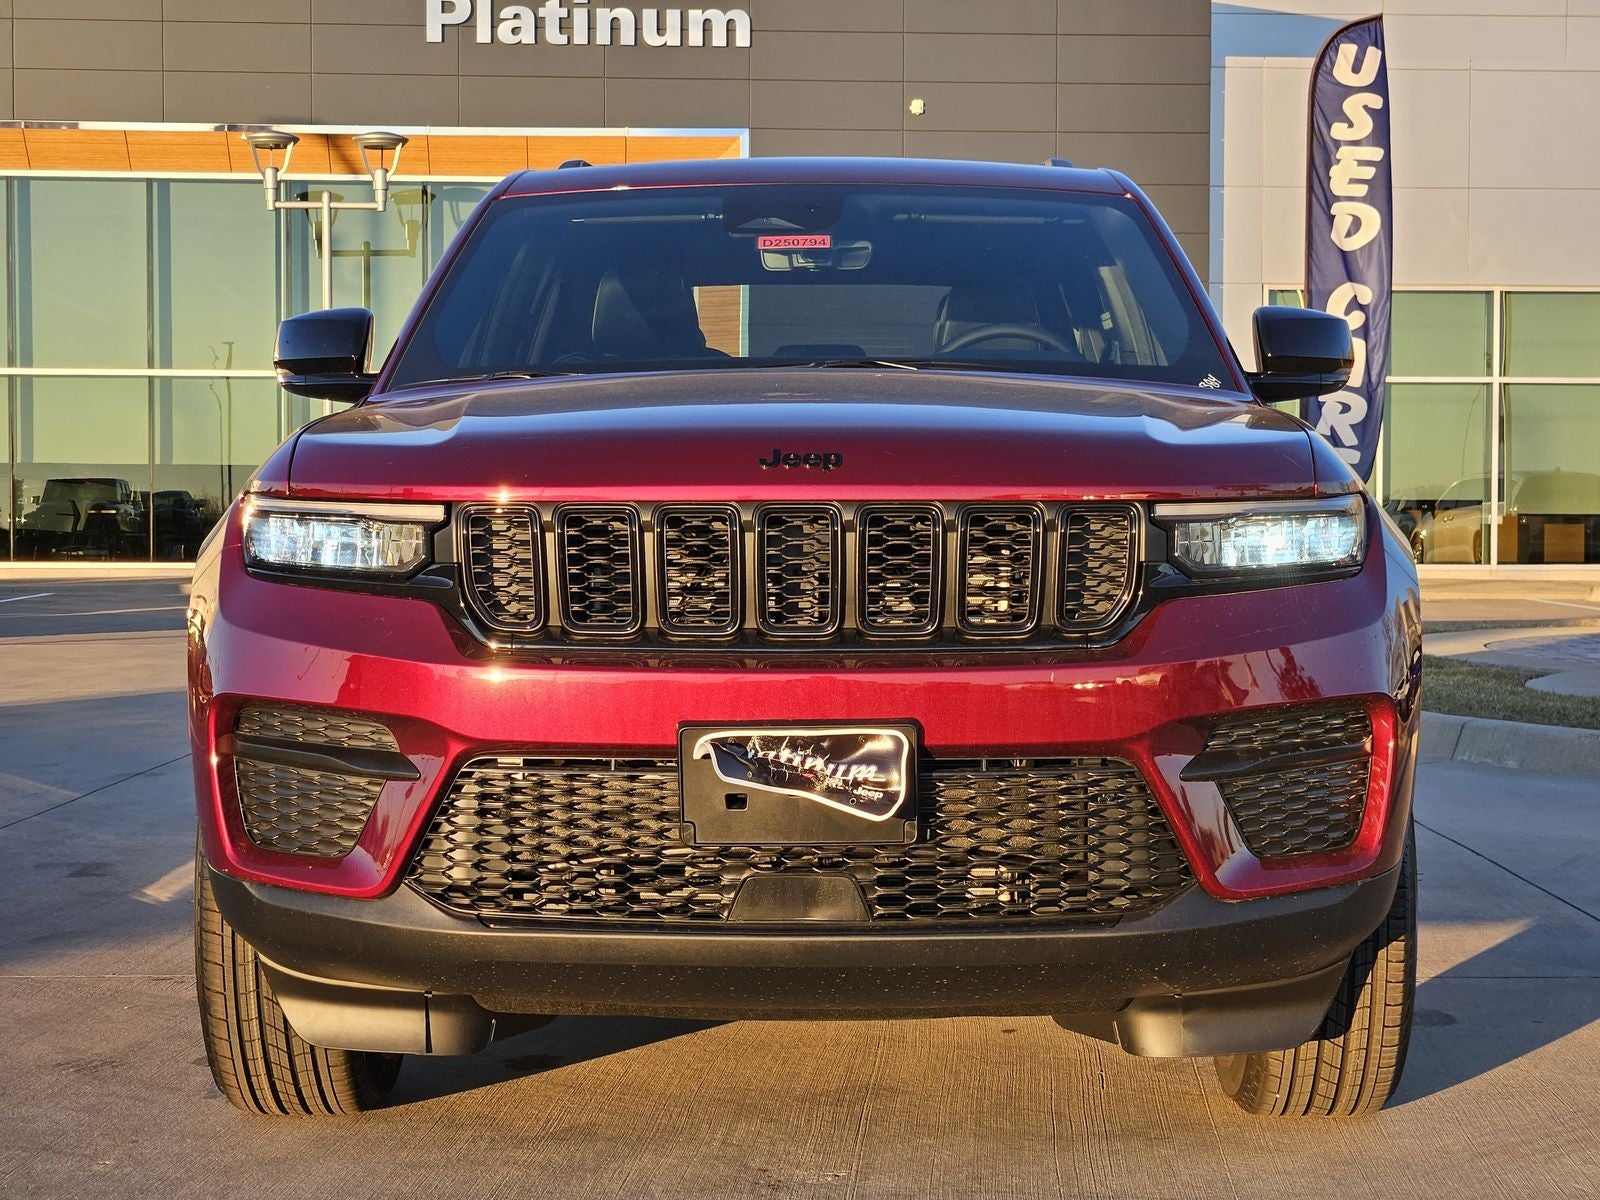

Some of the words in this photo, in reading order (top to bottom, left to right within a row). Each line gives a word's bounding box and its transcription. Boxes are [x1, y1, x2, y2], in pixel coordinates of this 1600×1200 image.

[426, 0, 752, 48] Platinum
[1329, 43, 1385, 252] USED
[762, 238, 827, 247] D250794
[1315, 281, 1373, 465] CR
[758, 448, 844, 473] Jeep
[853, 785, 884, 801] Jeep
